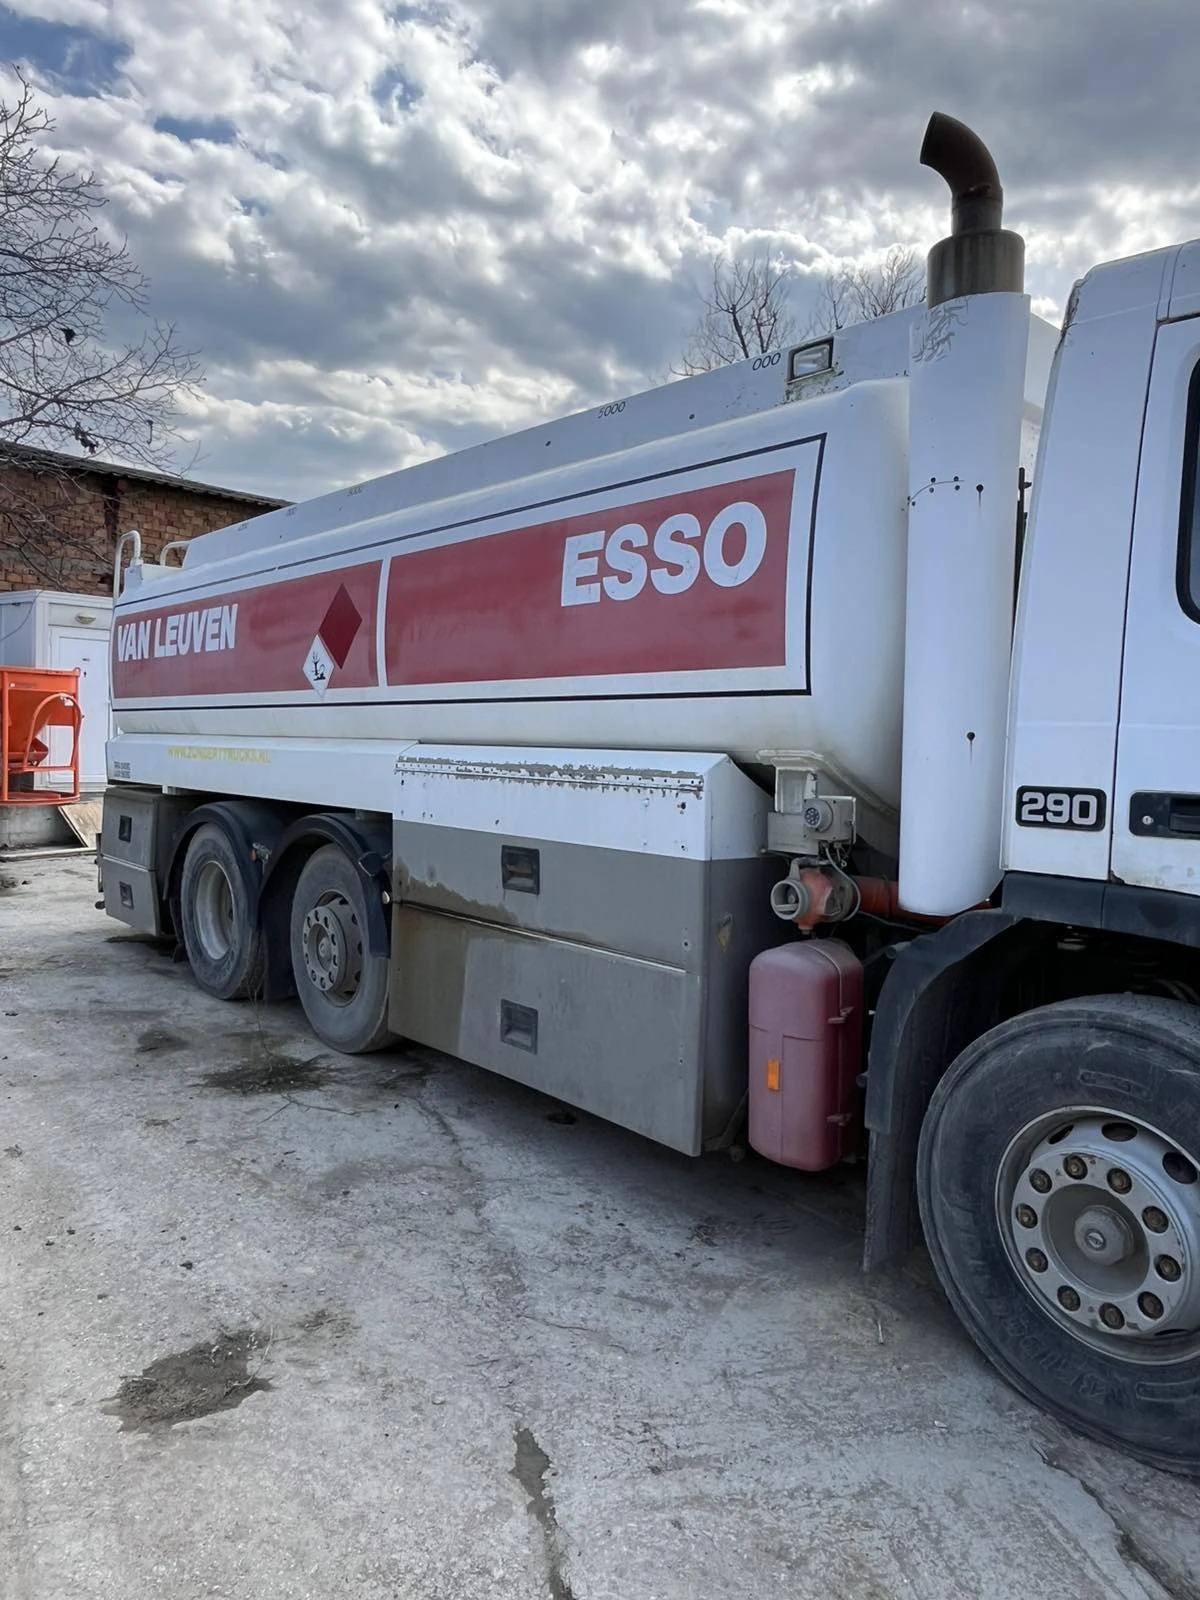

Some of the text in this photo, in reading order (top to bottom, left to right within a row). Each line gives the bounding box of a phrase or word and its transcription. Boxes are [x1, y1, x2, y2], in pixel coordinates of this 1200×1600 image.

[752, 352, 781, 371] 000
[561, 501, 767, 607] ESSO
[117, 603, 238, 662] VAN LEUVEN
[1021, 791, 1098, 825] 290
